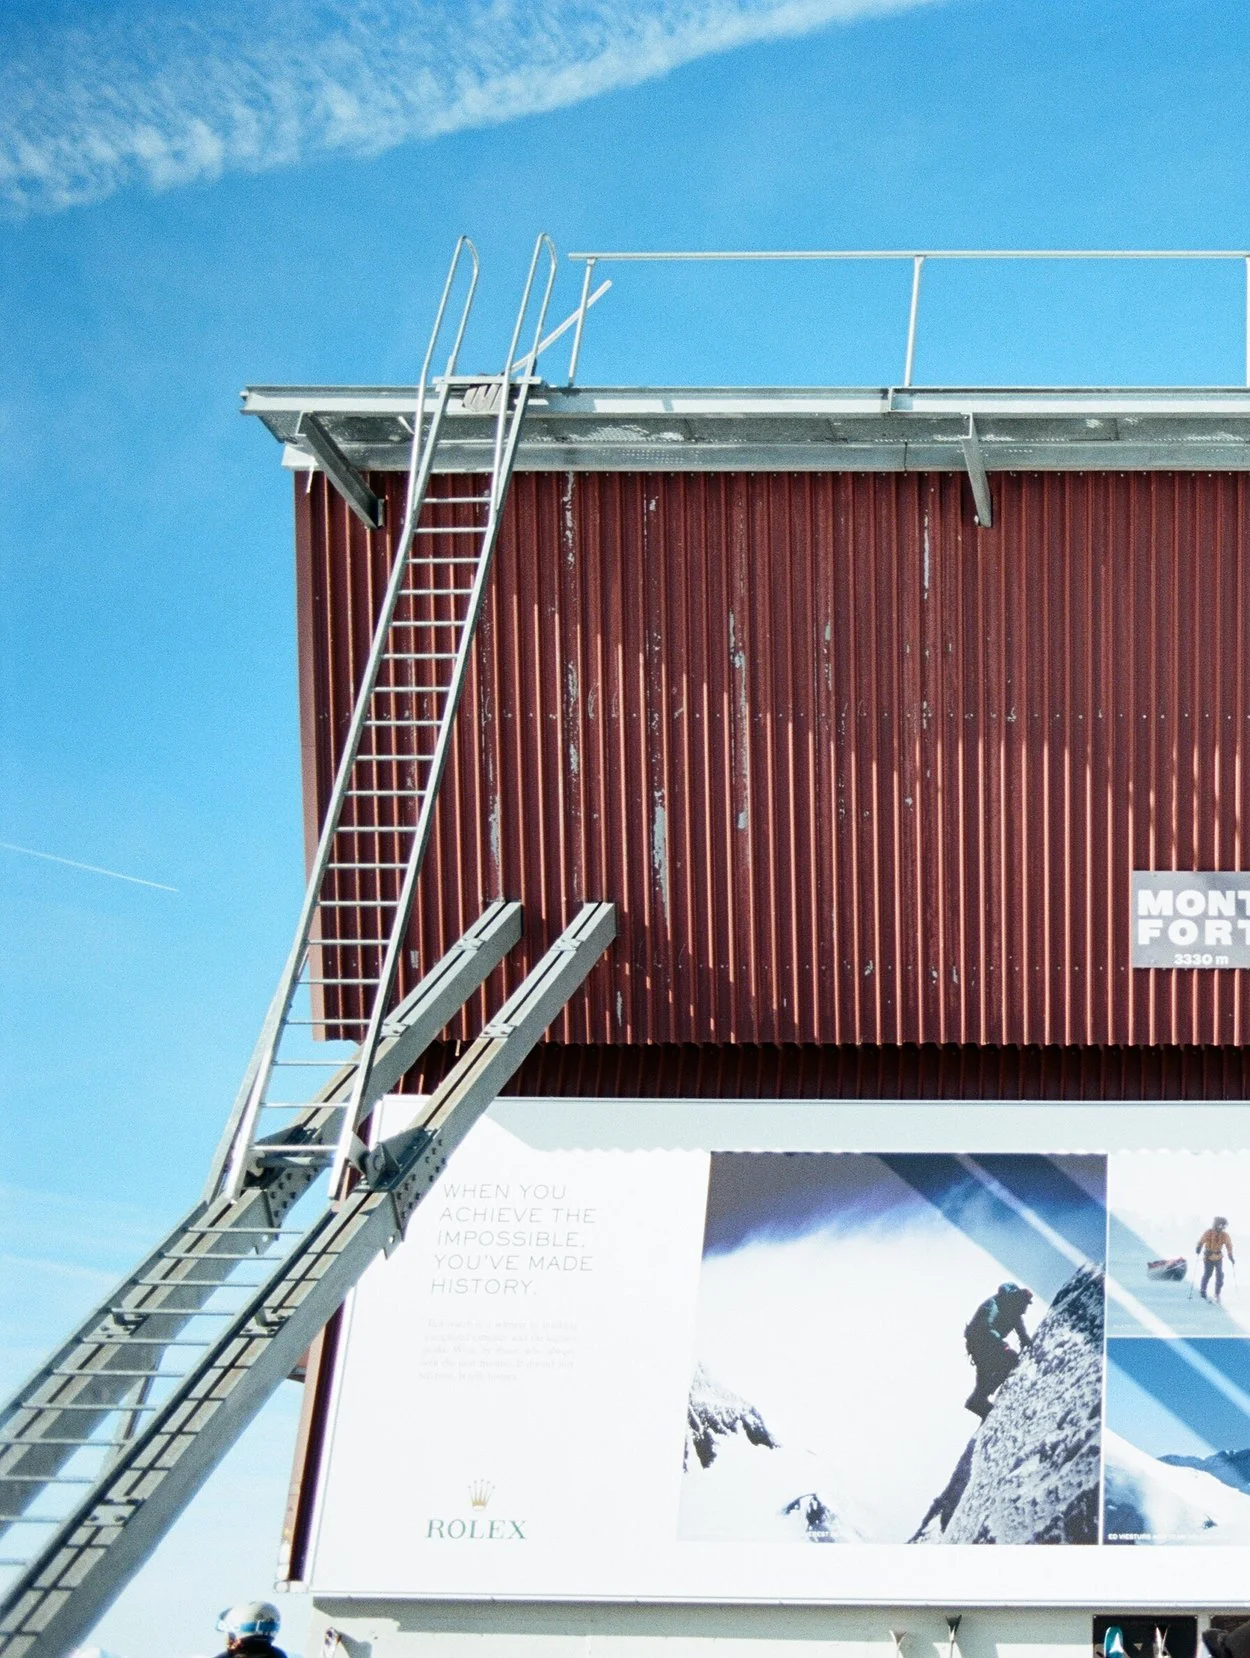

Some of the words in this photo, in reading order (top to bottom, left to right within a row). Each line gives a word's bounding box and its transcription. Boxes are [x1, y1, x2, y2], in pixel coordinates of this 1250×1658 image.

[1174, 953, 1213, 966] 3330
[1215, 955, 1230, 966] m
[443, 1183, 510, 1200] WHEN
[519, 1184, 567, 1200] YOU
[440, 1206, 543, 1223] ACHIEVE
[551, 1207, 597, 1224] THE
[434, 1254, 520, 1271] YOU'VE
[528, 1255, 594, 1272] MADE
[431, 1278, 538, 1296] HISTORY.
[425, 1518, 528, 1540] ROLEX
